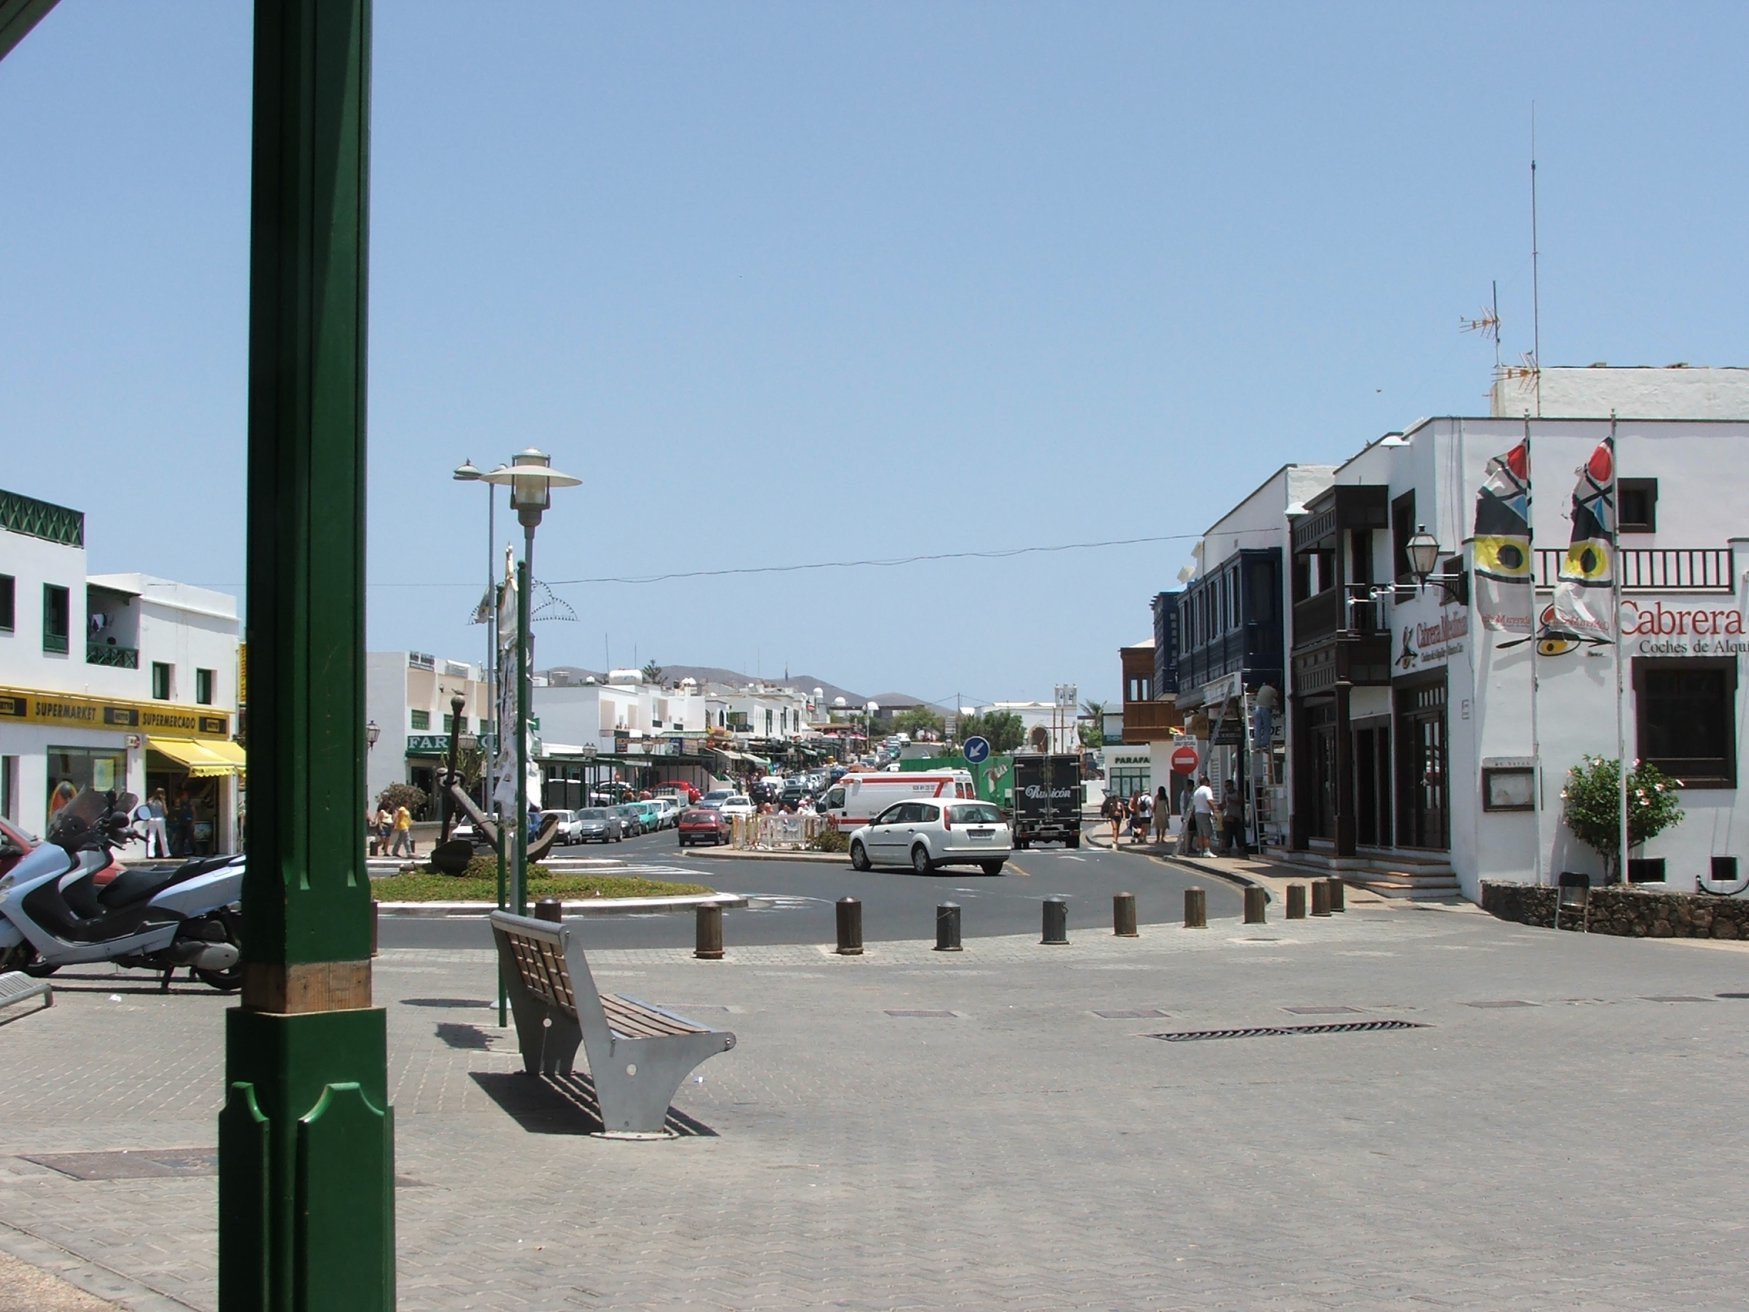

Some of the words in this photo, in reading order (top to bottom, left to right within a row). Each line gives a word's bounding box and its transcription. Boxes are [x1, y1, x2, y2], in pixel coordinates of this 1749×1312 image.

[1615, 600, 1746, 635] Cabrera
[1639, 640, 1688, 654] Coches
[1693, 640, 1710, 654] de
[36, 702, 96, 721] SUPERMARKET
[142, 713, 196, 729] SUPERMERCADO
